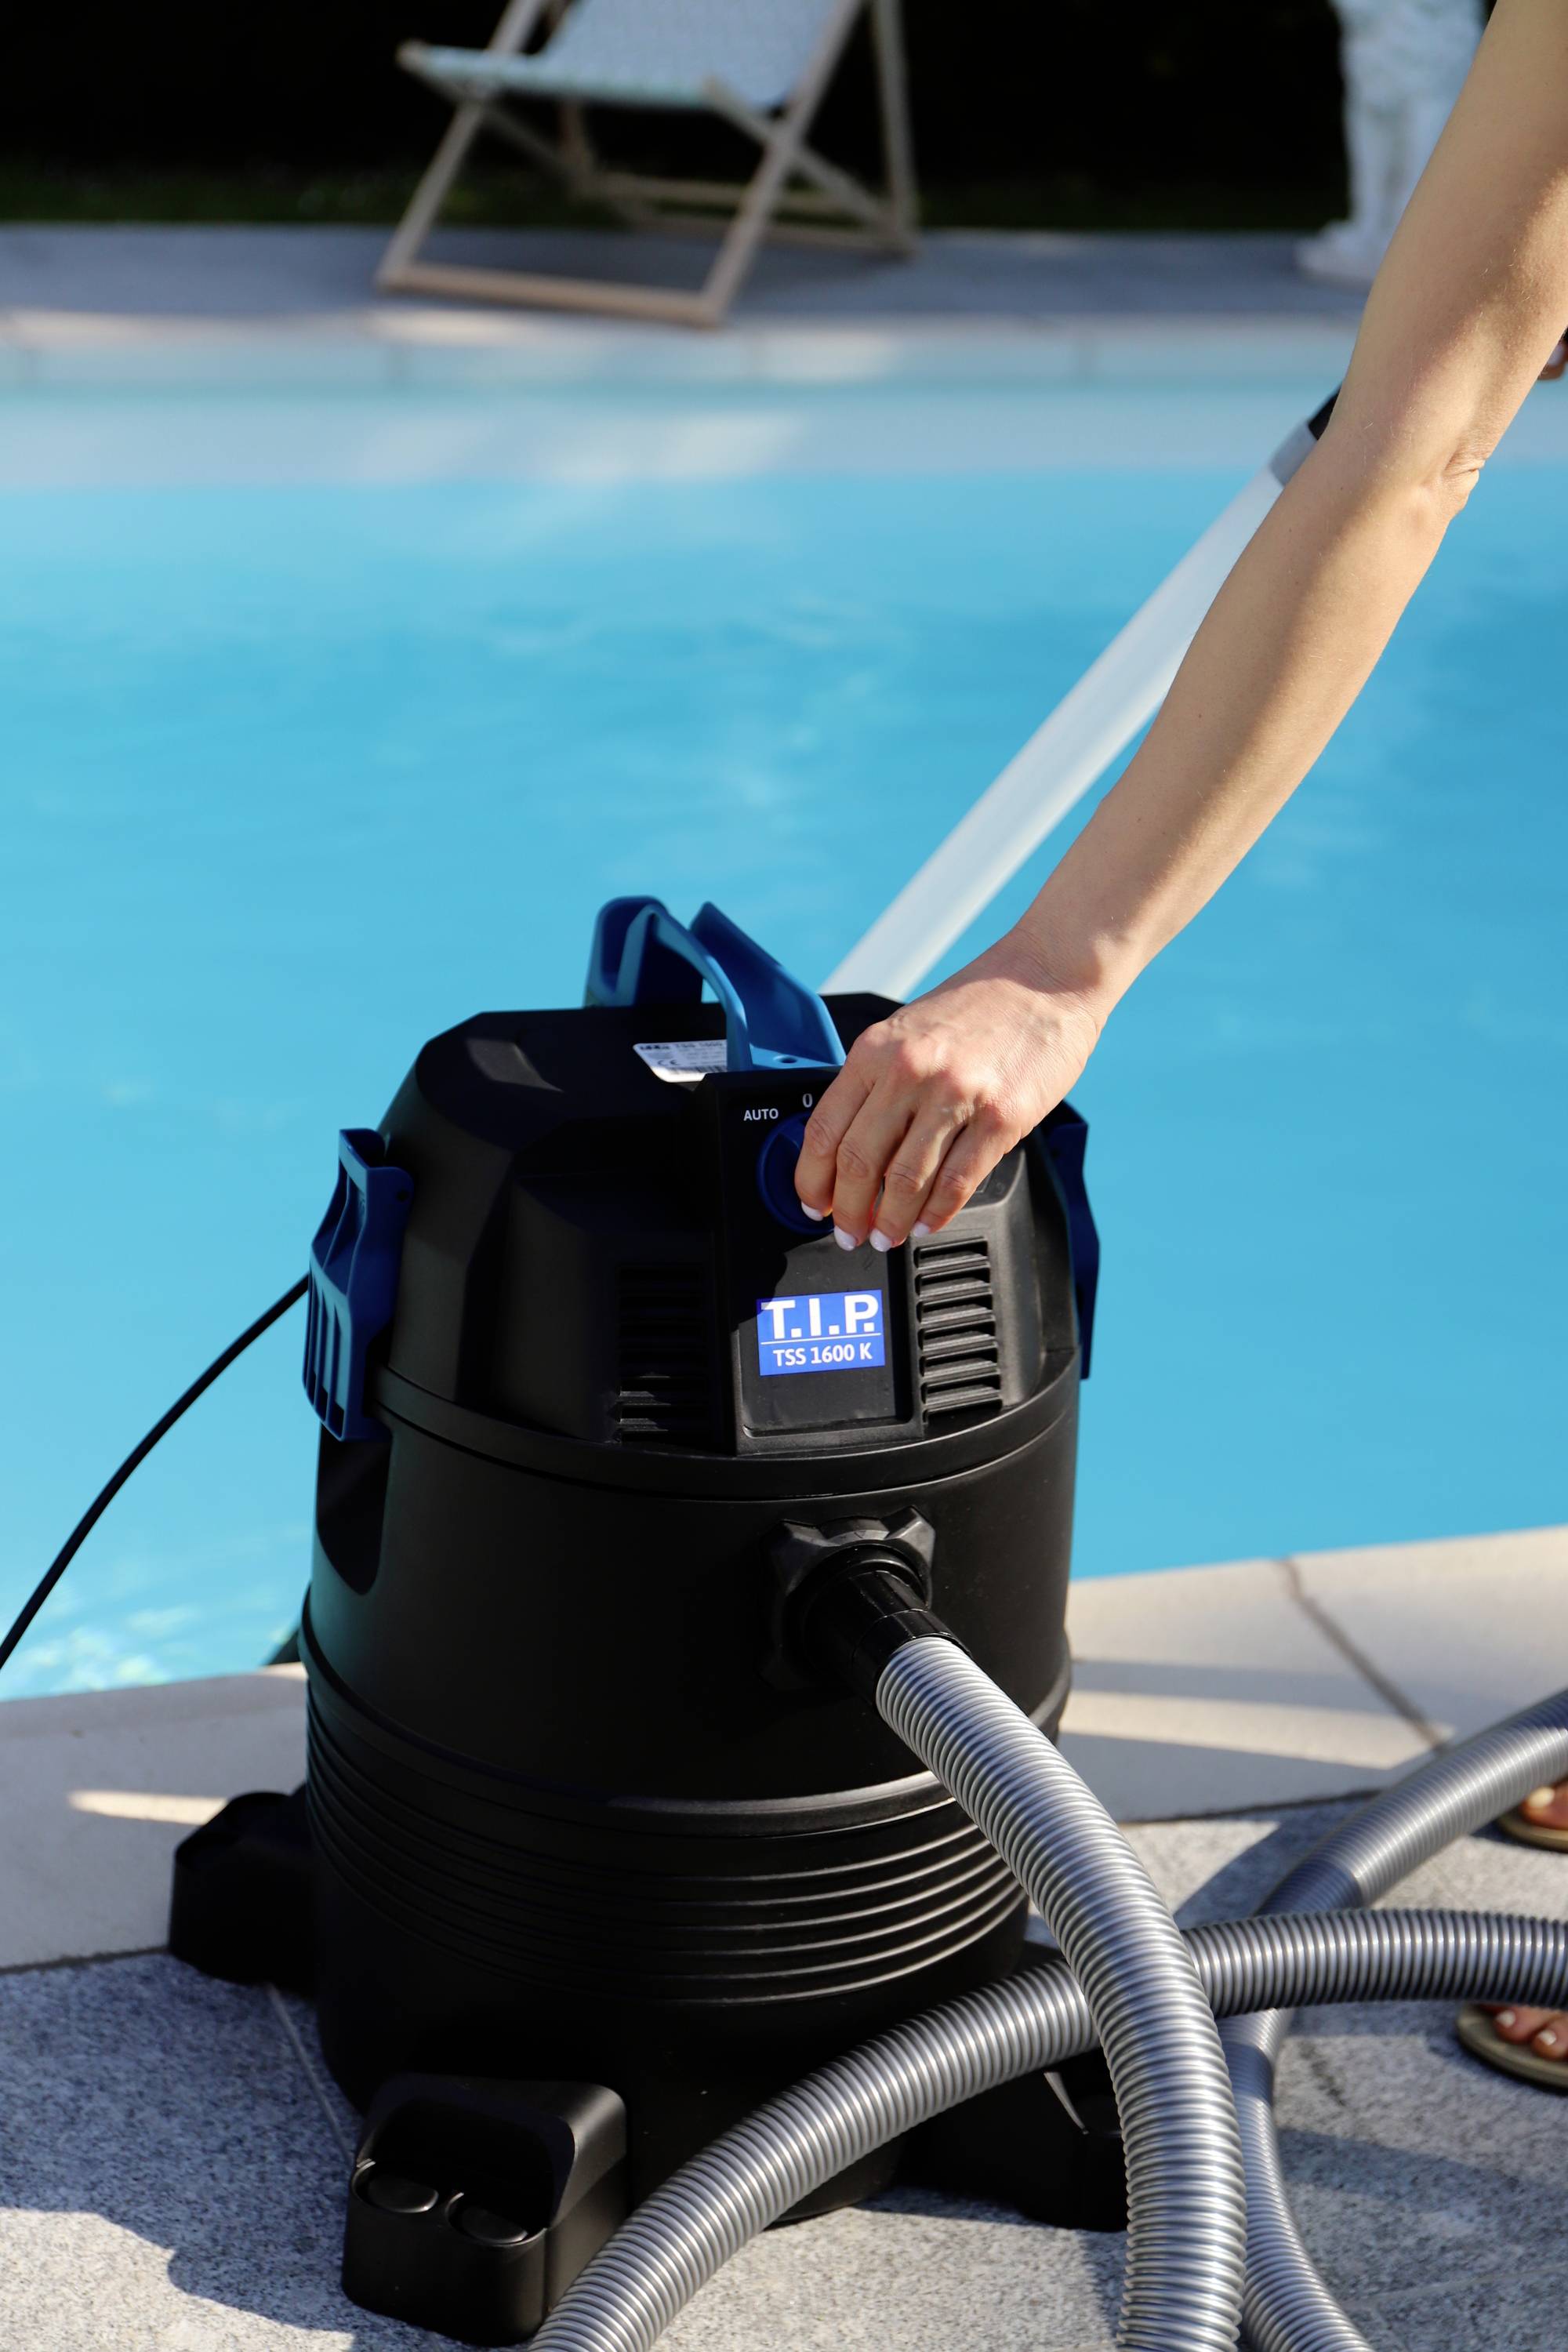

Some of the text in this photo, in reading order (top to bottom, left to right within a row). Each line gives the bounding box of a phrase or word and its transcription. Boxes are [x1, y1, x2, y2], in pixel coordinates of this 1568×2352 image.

[802, 1093, 813, 1108] 0
[743, 1108, 779, 1121] AUTO
[760, 1294, 879, 1340] T.I.P.
[772, 1342, 873, 1367] TSS 1600 K
